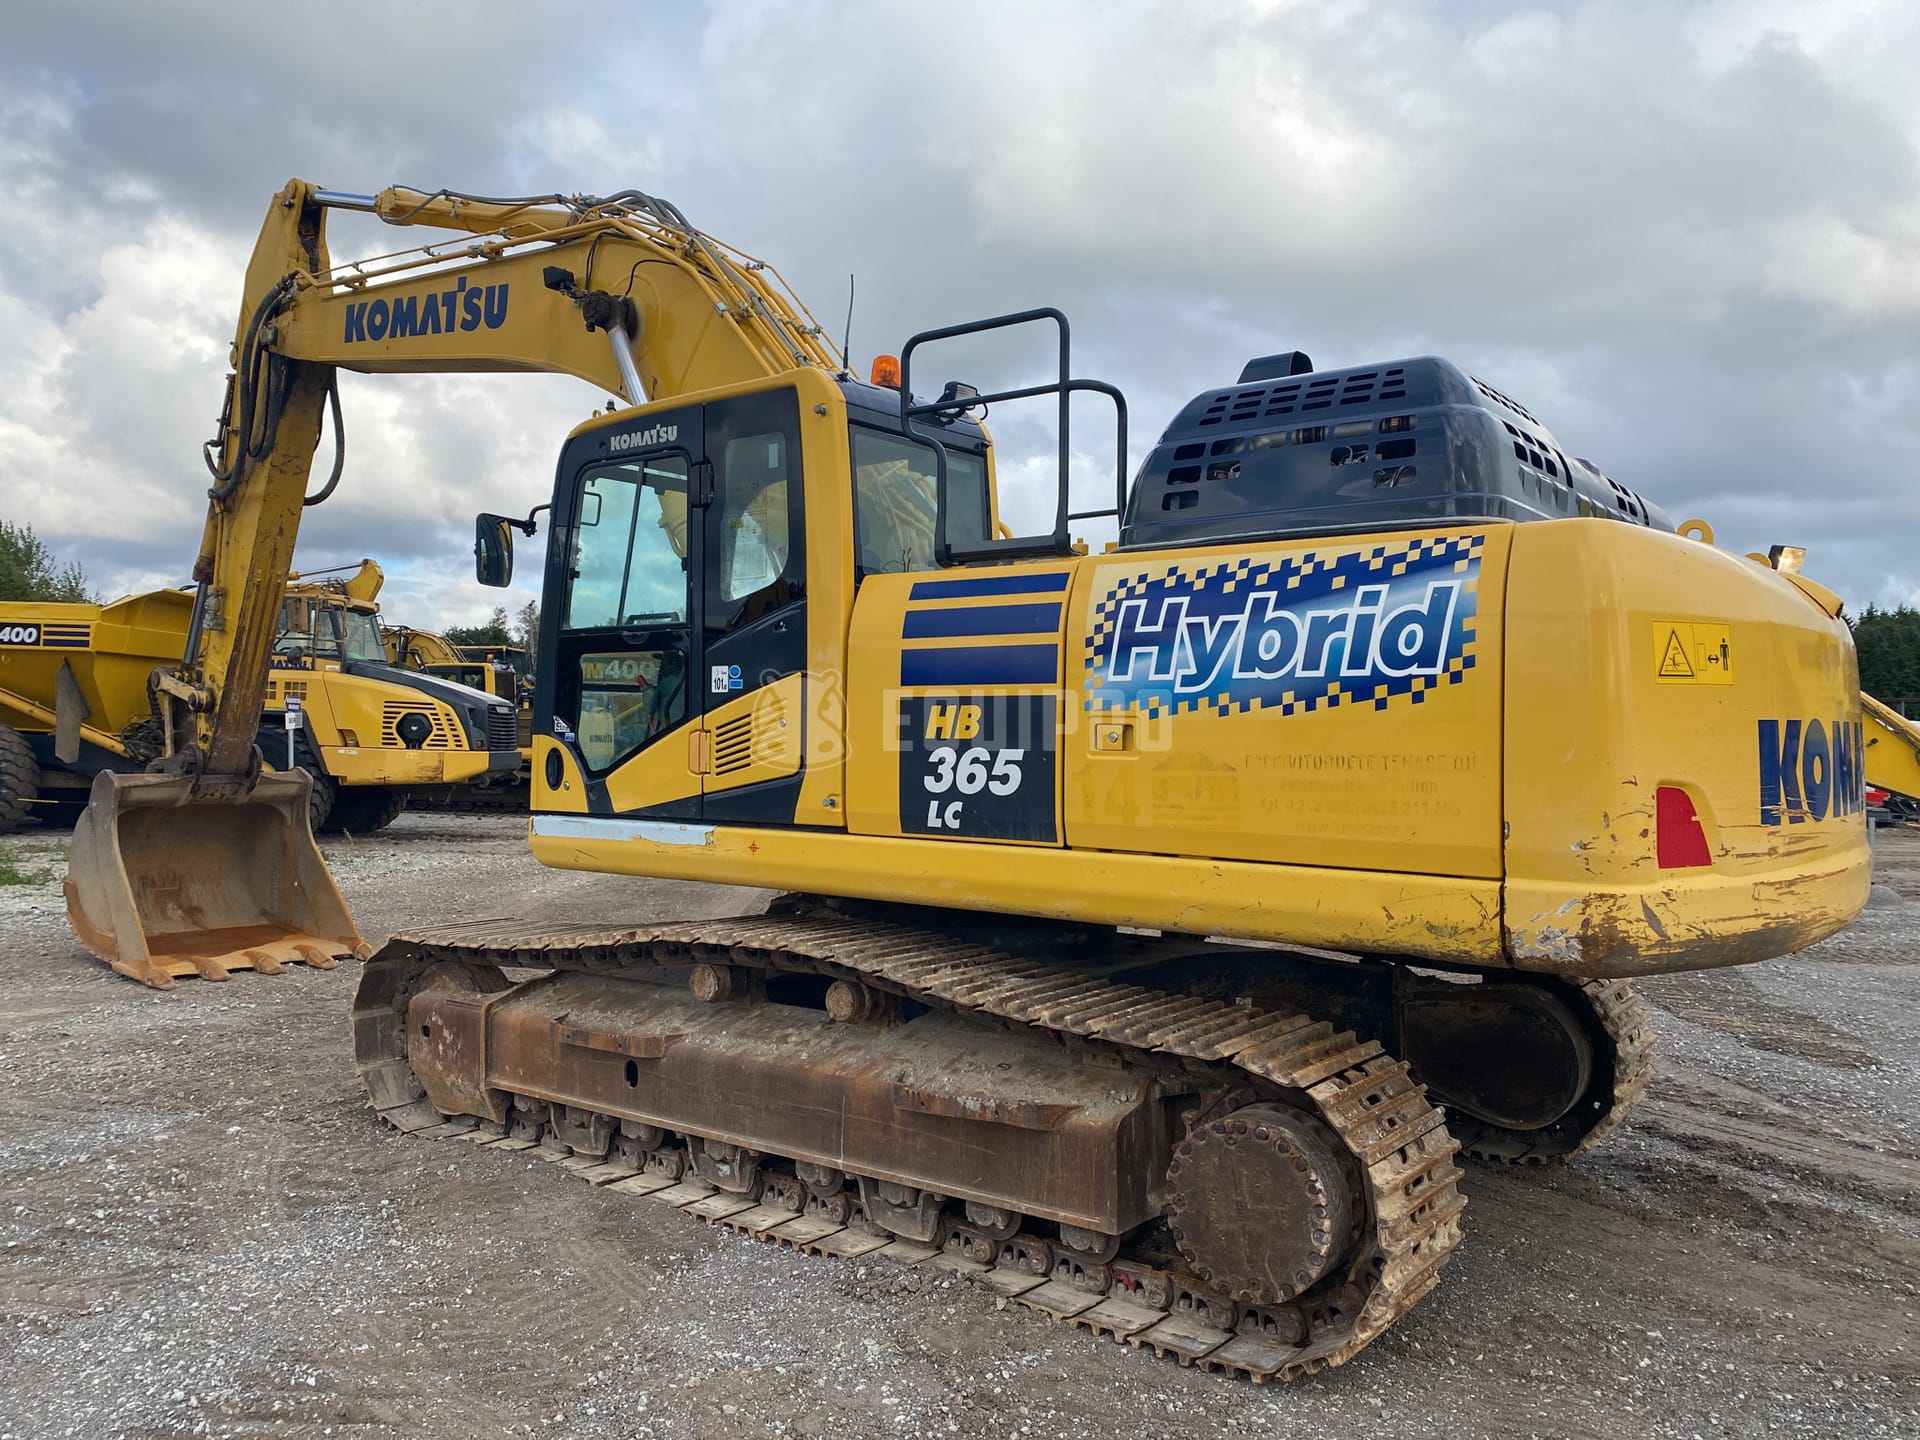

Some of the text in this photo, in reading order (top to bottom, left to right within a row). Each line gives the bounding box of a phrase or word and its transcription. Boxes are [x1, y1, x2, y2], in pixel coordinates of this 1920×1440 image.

[344, 276, 509, 344] KOMATSU
[610, 423, 678, 451] KOMATSU
[1107, 579, 1461, 693] Hybrid
[925, 704, 982, 740] HB
[923, 746, 1024, 796] 365
[926, 800, 963, 829] LC
